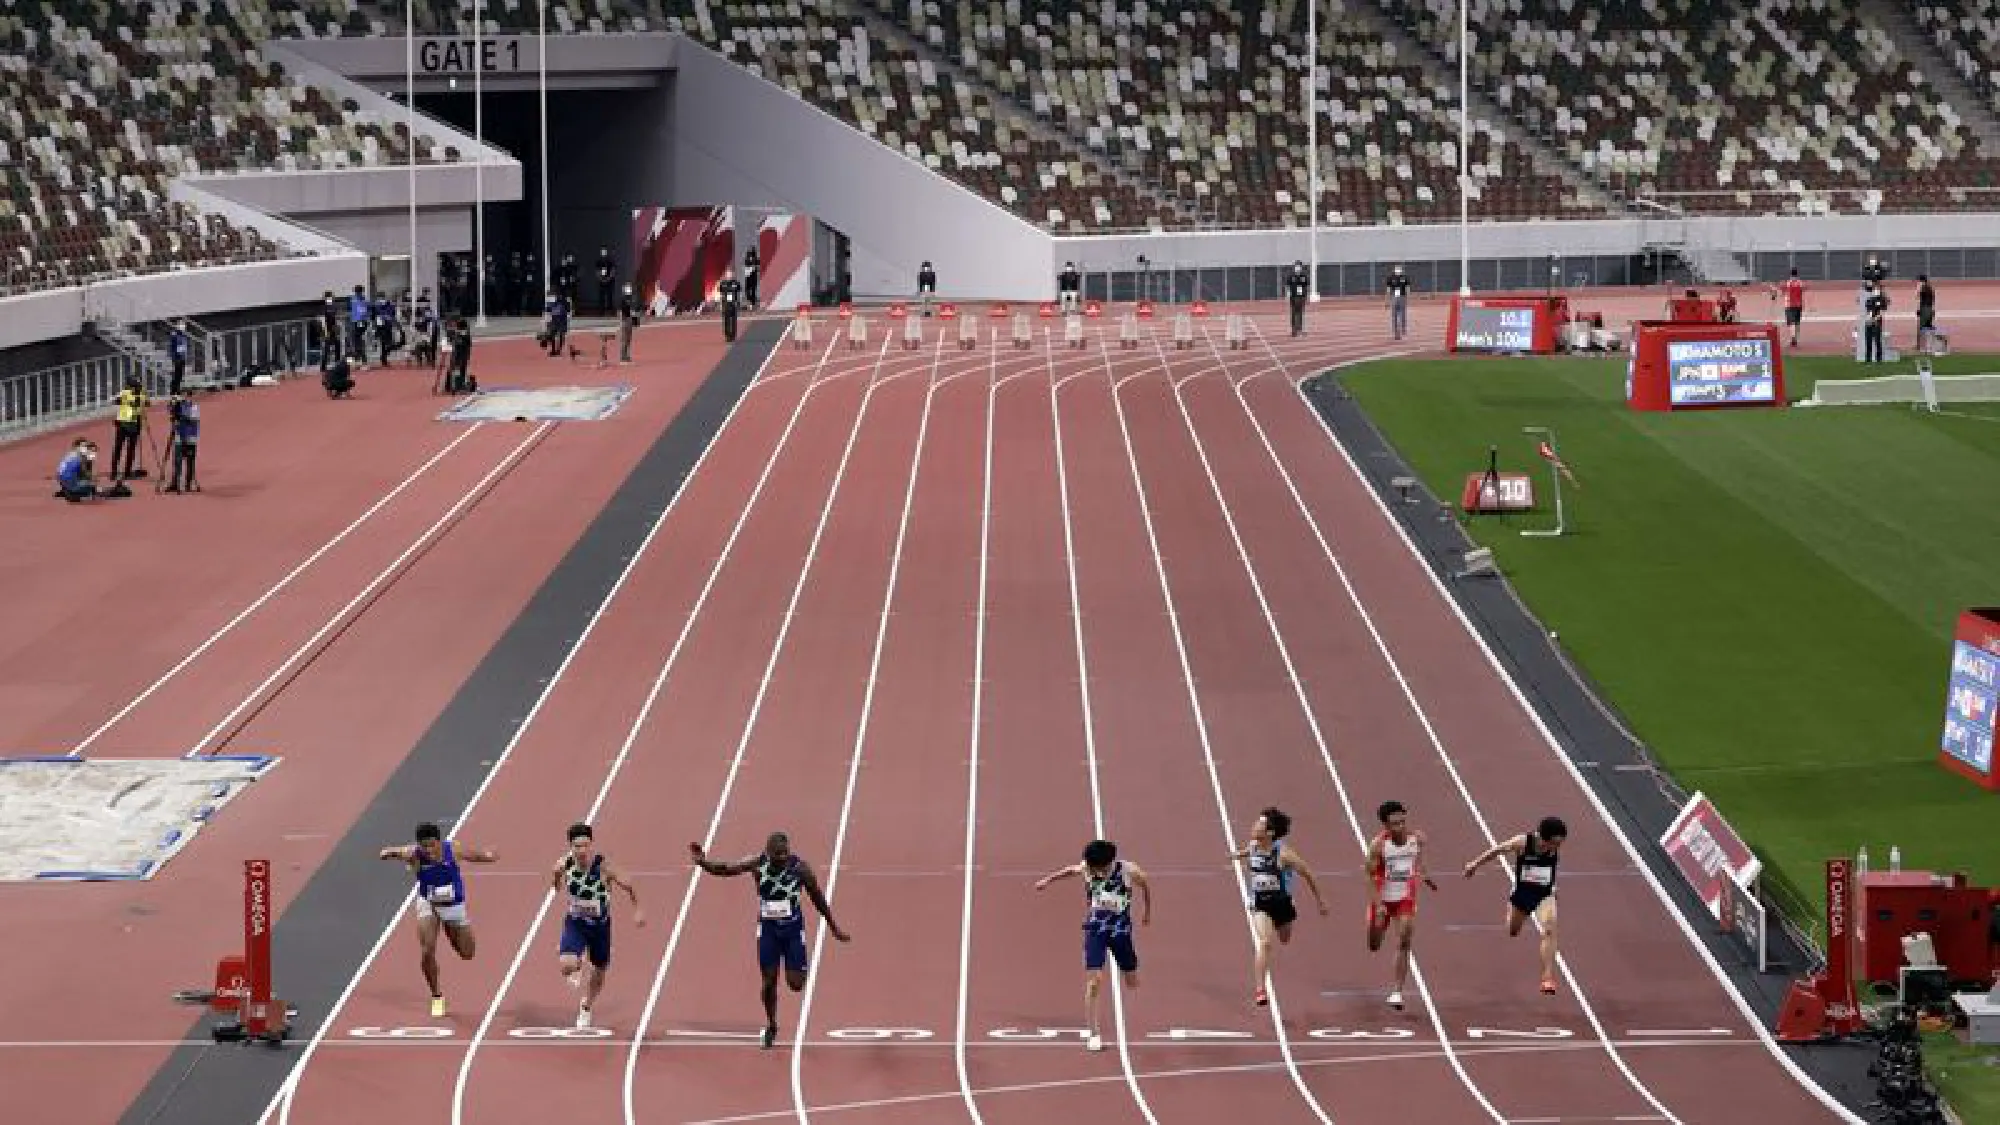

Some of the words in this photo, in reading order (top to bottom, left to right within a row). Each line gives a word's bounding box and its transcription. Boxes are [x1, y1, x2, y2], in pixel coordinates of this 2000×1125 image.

[421, 40, 497, 71] GATE
[506, 40, 518, 70] 1
[1308, 1026, 1415, 1039] 3
[1466, 1026, 1575, 1038] 2
